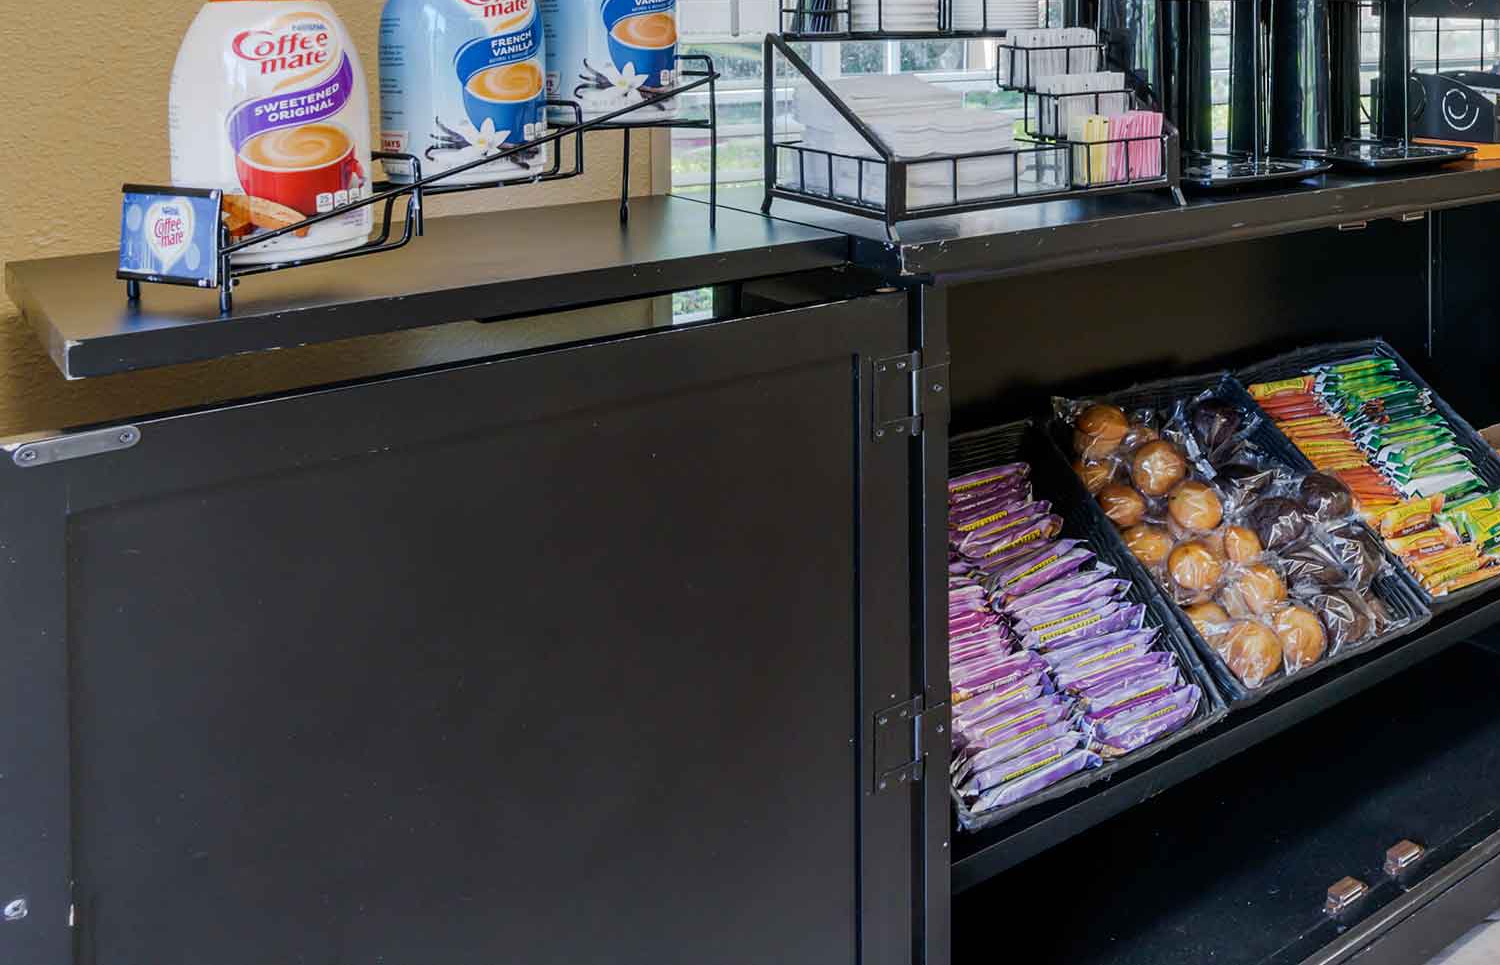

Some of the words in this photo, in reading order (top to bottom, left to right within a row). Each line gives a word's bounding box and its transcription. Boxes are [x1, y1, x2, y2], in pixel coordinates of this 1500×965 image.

[231, 30, 328, 61] Coffee
[491, 31, 532, 49] FRENCH
[492, 40, 533, 57] VANILLA
[260, 49, 328, 76] mate
[254, 83, 340, 117] SWEETENED
[267, 99, 335, 123] ORIGINAL
[154, 218, 182, 237] Coffee
[160, 231, 184, 248] mate
